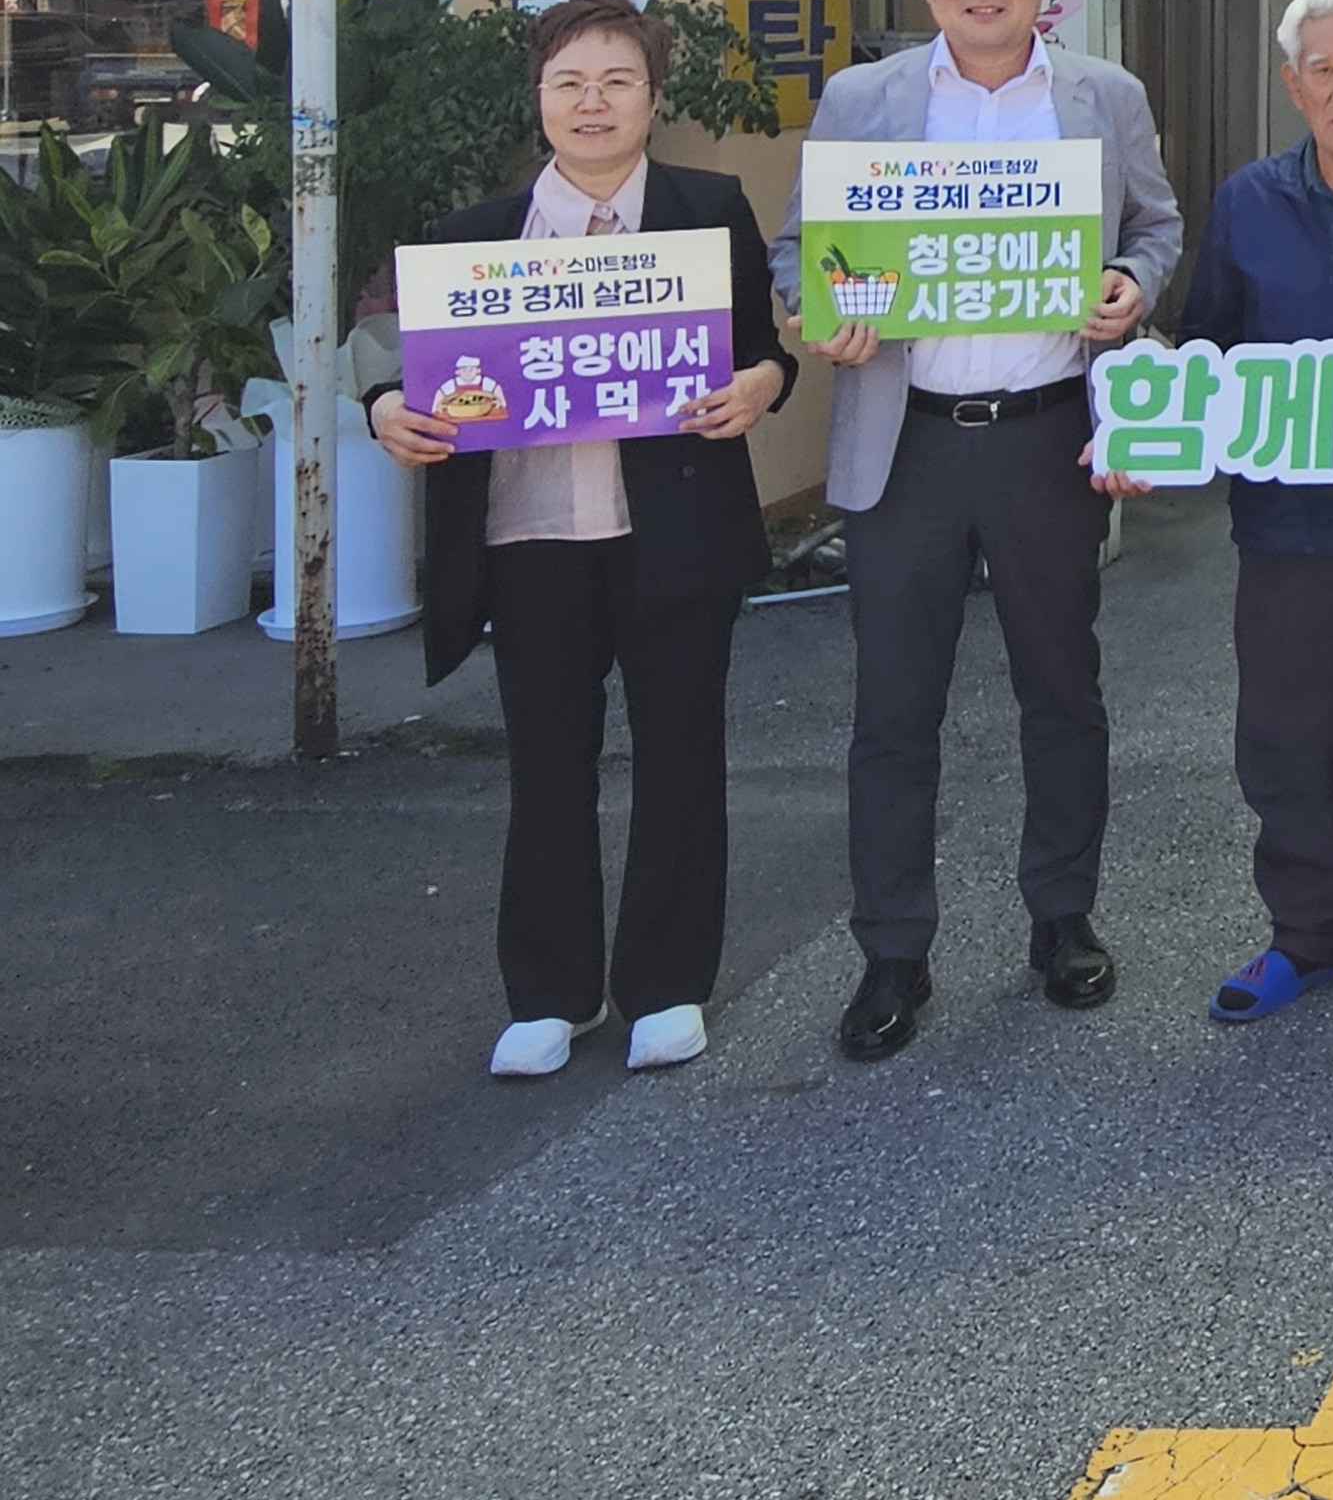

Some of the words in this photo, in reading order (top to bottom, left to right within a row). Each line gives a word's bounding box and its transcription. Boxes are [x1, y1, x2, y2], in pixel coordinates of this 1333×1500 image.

[847, 185, 904, 211] 청양
[913, 183, 969, 210] 경제
[978, 182, 1061, 208] 살리기
[908, 229, 1081, 275] 청양에서
[448, 288, 513, 317] 청양
[522, 281, 584, 312] 경제
[593, 276, 684, 308] 살리기
[908, 276, 1084, 323] 시장가자
[519, 325, 709, 381] 청양에서
